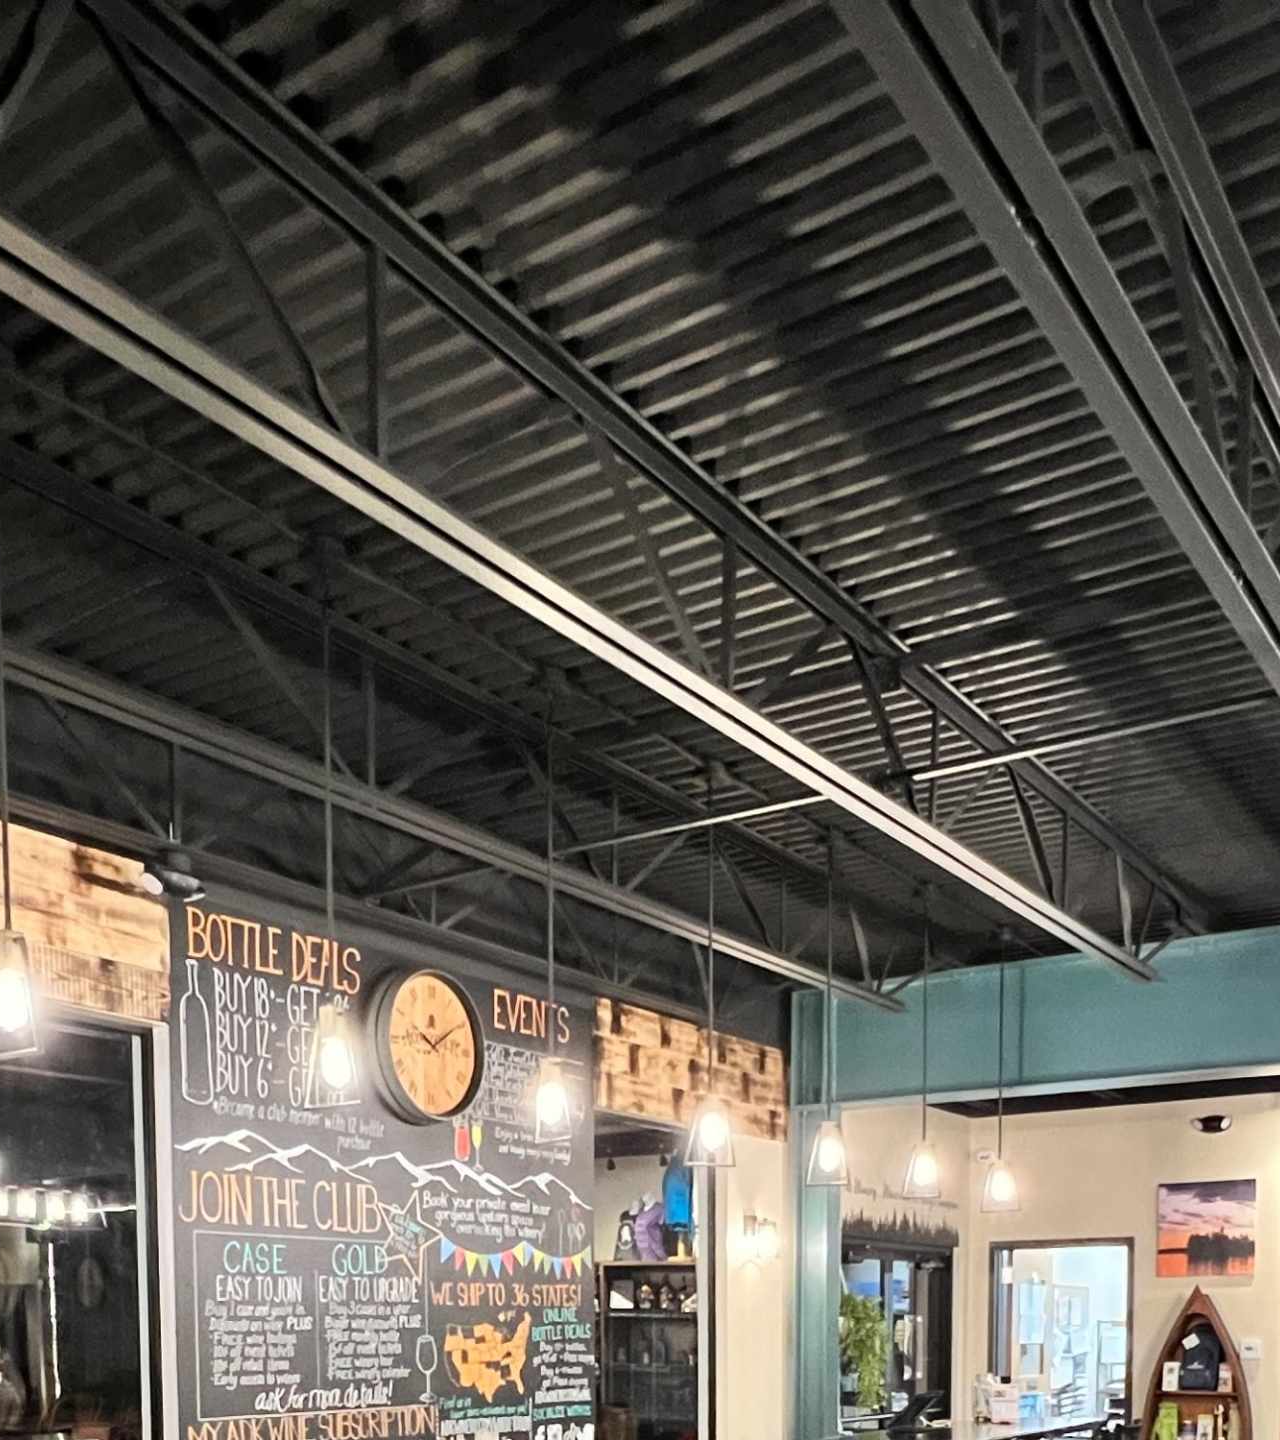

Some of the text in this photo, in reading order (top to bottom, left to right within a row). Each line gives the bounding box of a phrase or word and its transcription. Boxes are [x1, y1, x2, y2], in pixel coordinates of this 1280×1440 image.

[186, 906, 361, 995] BOTTLE DEALS
[212, 967, 252, 1015] BUY
[287, 984, 320, 1026] GET
[216, 1012, 253, 1053] BUY
[287, 1027, 313, 1065] GE
[216, 1053, 253, 1097] BUY
[178, 1170, 253, 1225] JOIN
[254, 1176, 308, 1229] THE
[313, 1180, 381, 1234] CLUB
[423, 1190, 449, 1209] Book
[223, 1240, 388, 1276] CASE GOLD
[216, 1275, 303, 1303] EASY TO JOIN
[319, 1275, 419, 1303] EASY TO UPGRADE
[431, 1282, 453, 1306] WE
[457, 1282, 485, 1307] SHIP
[486, 1283, 505, 1306] TO
[511, 1282, 530, 1306] 36
[286, 1316, 313, 1330] PLUS
[543, 1308, 578, 1324] ONLINE
[532, 1325, 562, 1341] BOTTLE
